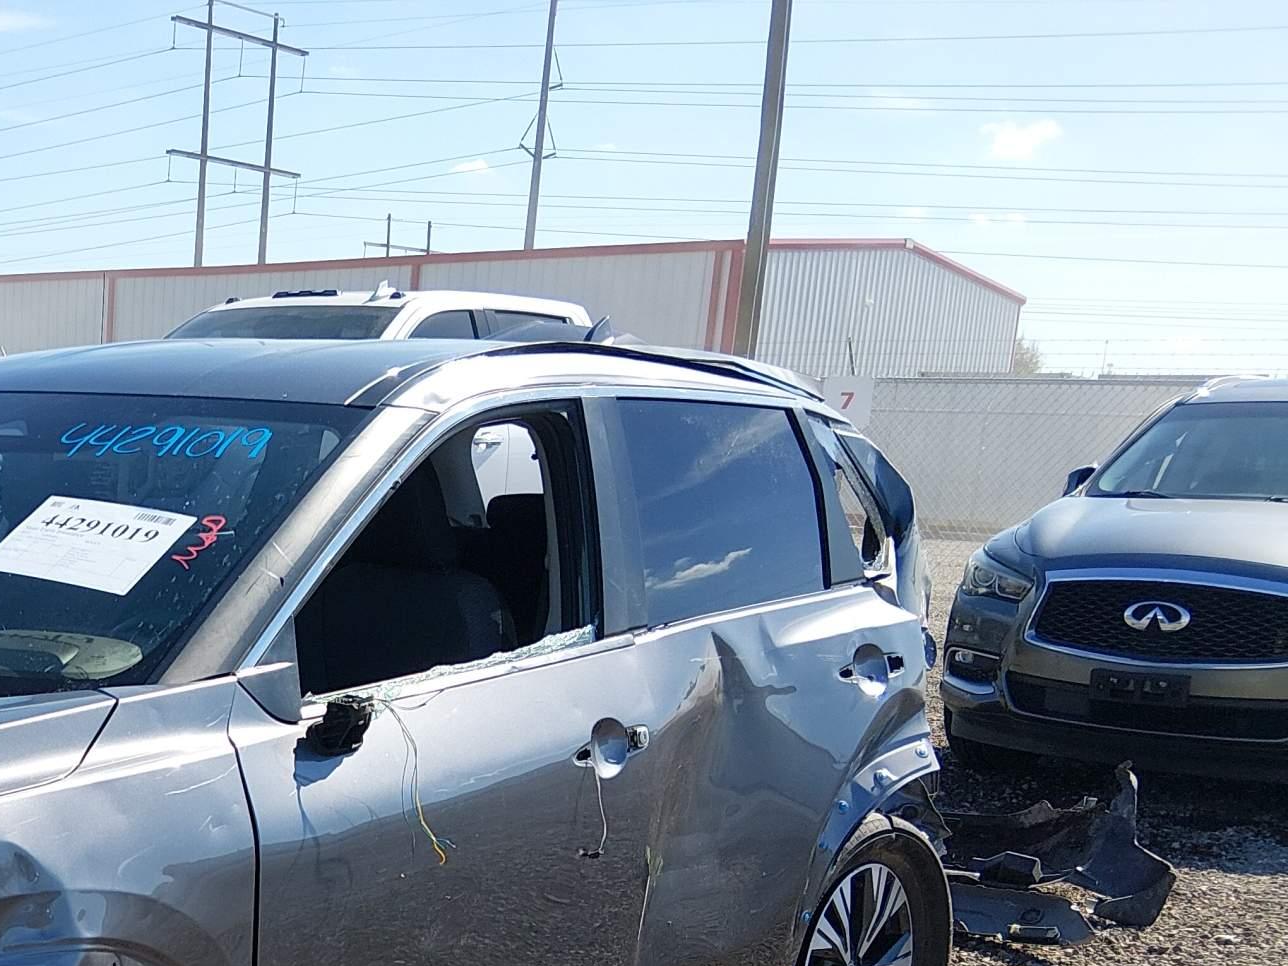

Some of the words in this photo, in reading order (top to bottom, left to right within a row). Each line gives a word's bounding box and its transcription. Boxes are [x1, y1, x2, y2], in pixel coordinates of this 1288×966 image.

[840, 391, 855, 410] 7
[60, 424, 273, 459] 44291019
[41, 513, 161, 543] 44291019
